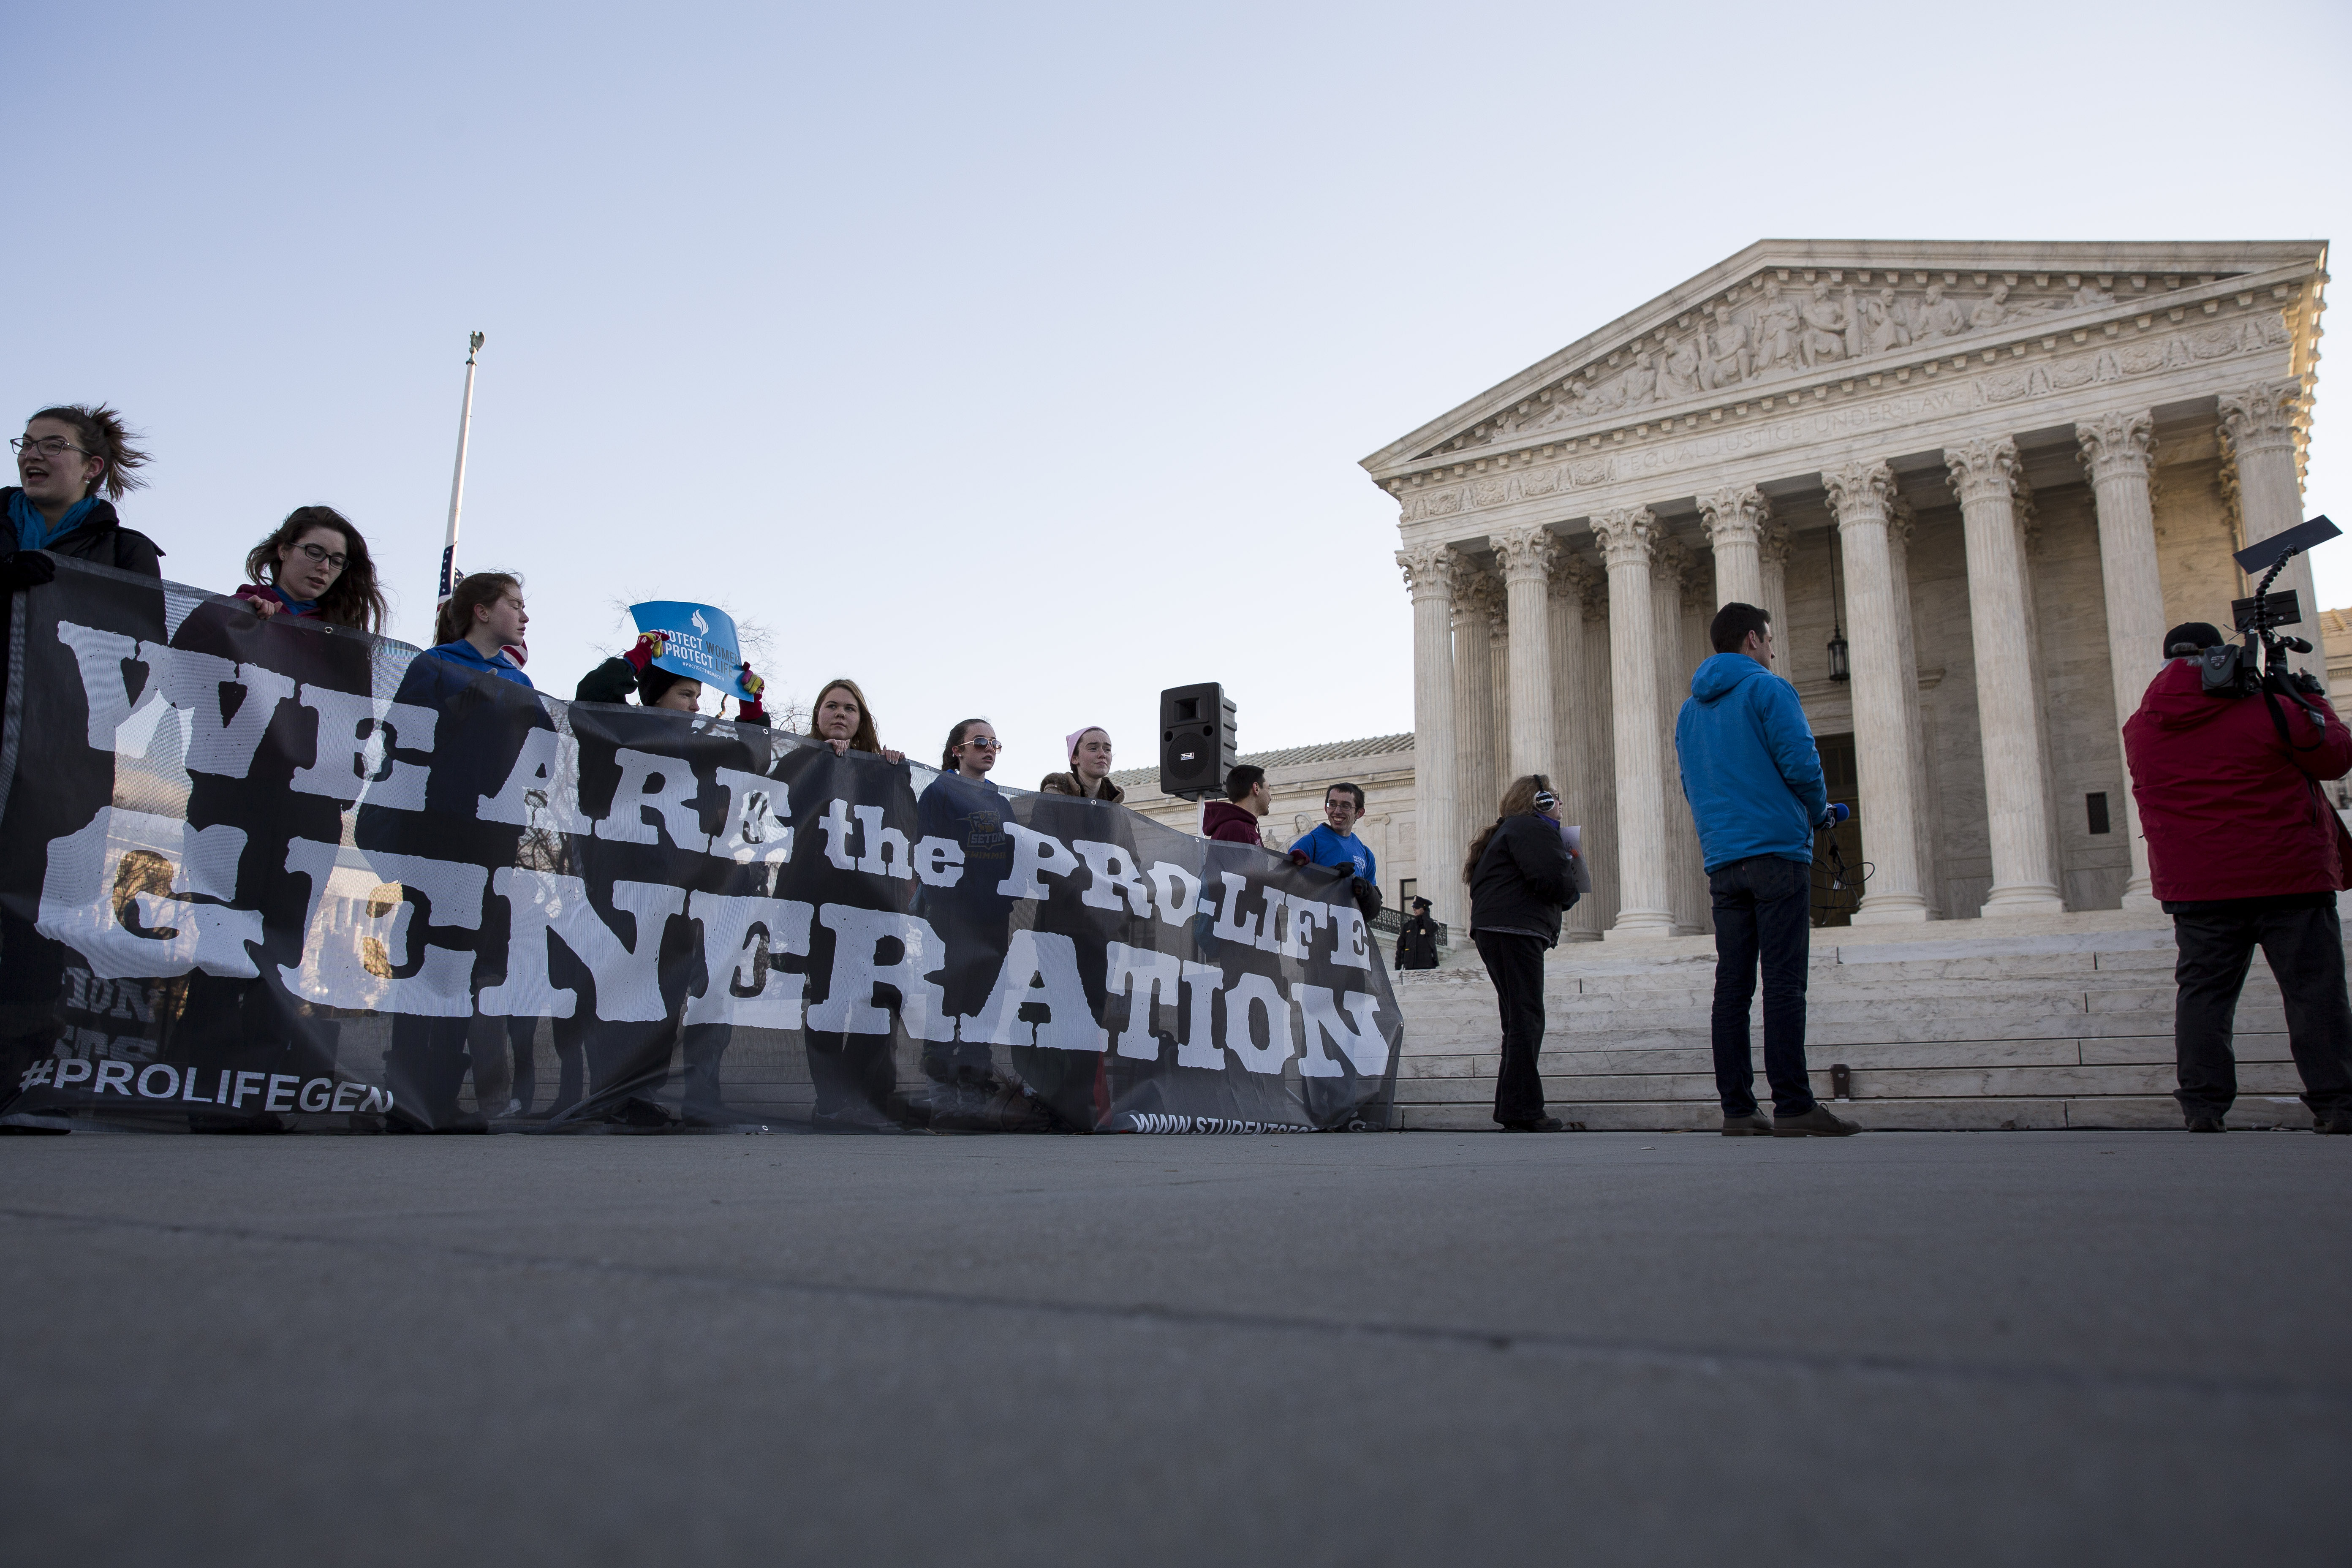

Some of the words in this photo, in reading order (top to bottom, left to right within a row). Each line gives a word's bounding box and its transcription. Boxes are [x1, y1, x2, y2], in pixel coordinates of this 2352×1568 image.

[1631, 442, 1705, 472] EQUAL
[1710, 425, 1803, 456] JUSTICE
[1813, 402, 1893, 433] UNDER
[1907, 389, 1958, 414] LAW
[650, 629, 702, 650] OTECT
[706, 641, 740, 665] WOMEN
[665, 642, 712, 668] PROTECT
[682, 662, 724, 681] #PROTECTTHEMBOTH
[57, 620, 438, 812] WE
[476, 727, 794, 863] ARE
[818, 798, 965, 888] the
[997, 821, 1371, 971] PRO-LIFE
[971, 832, 1005, 844] SETON
[34, 805, 1389, 1077] GENERATION
[19, 1058, 394, 1113] #PROLIFEGEN
